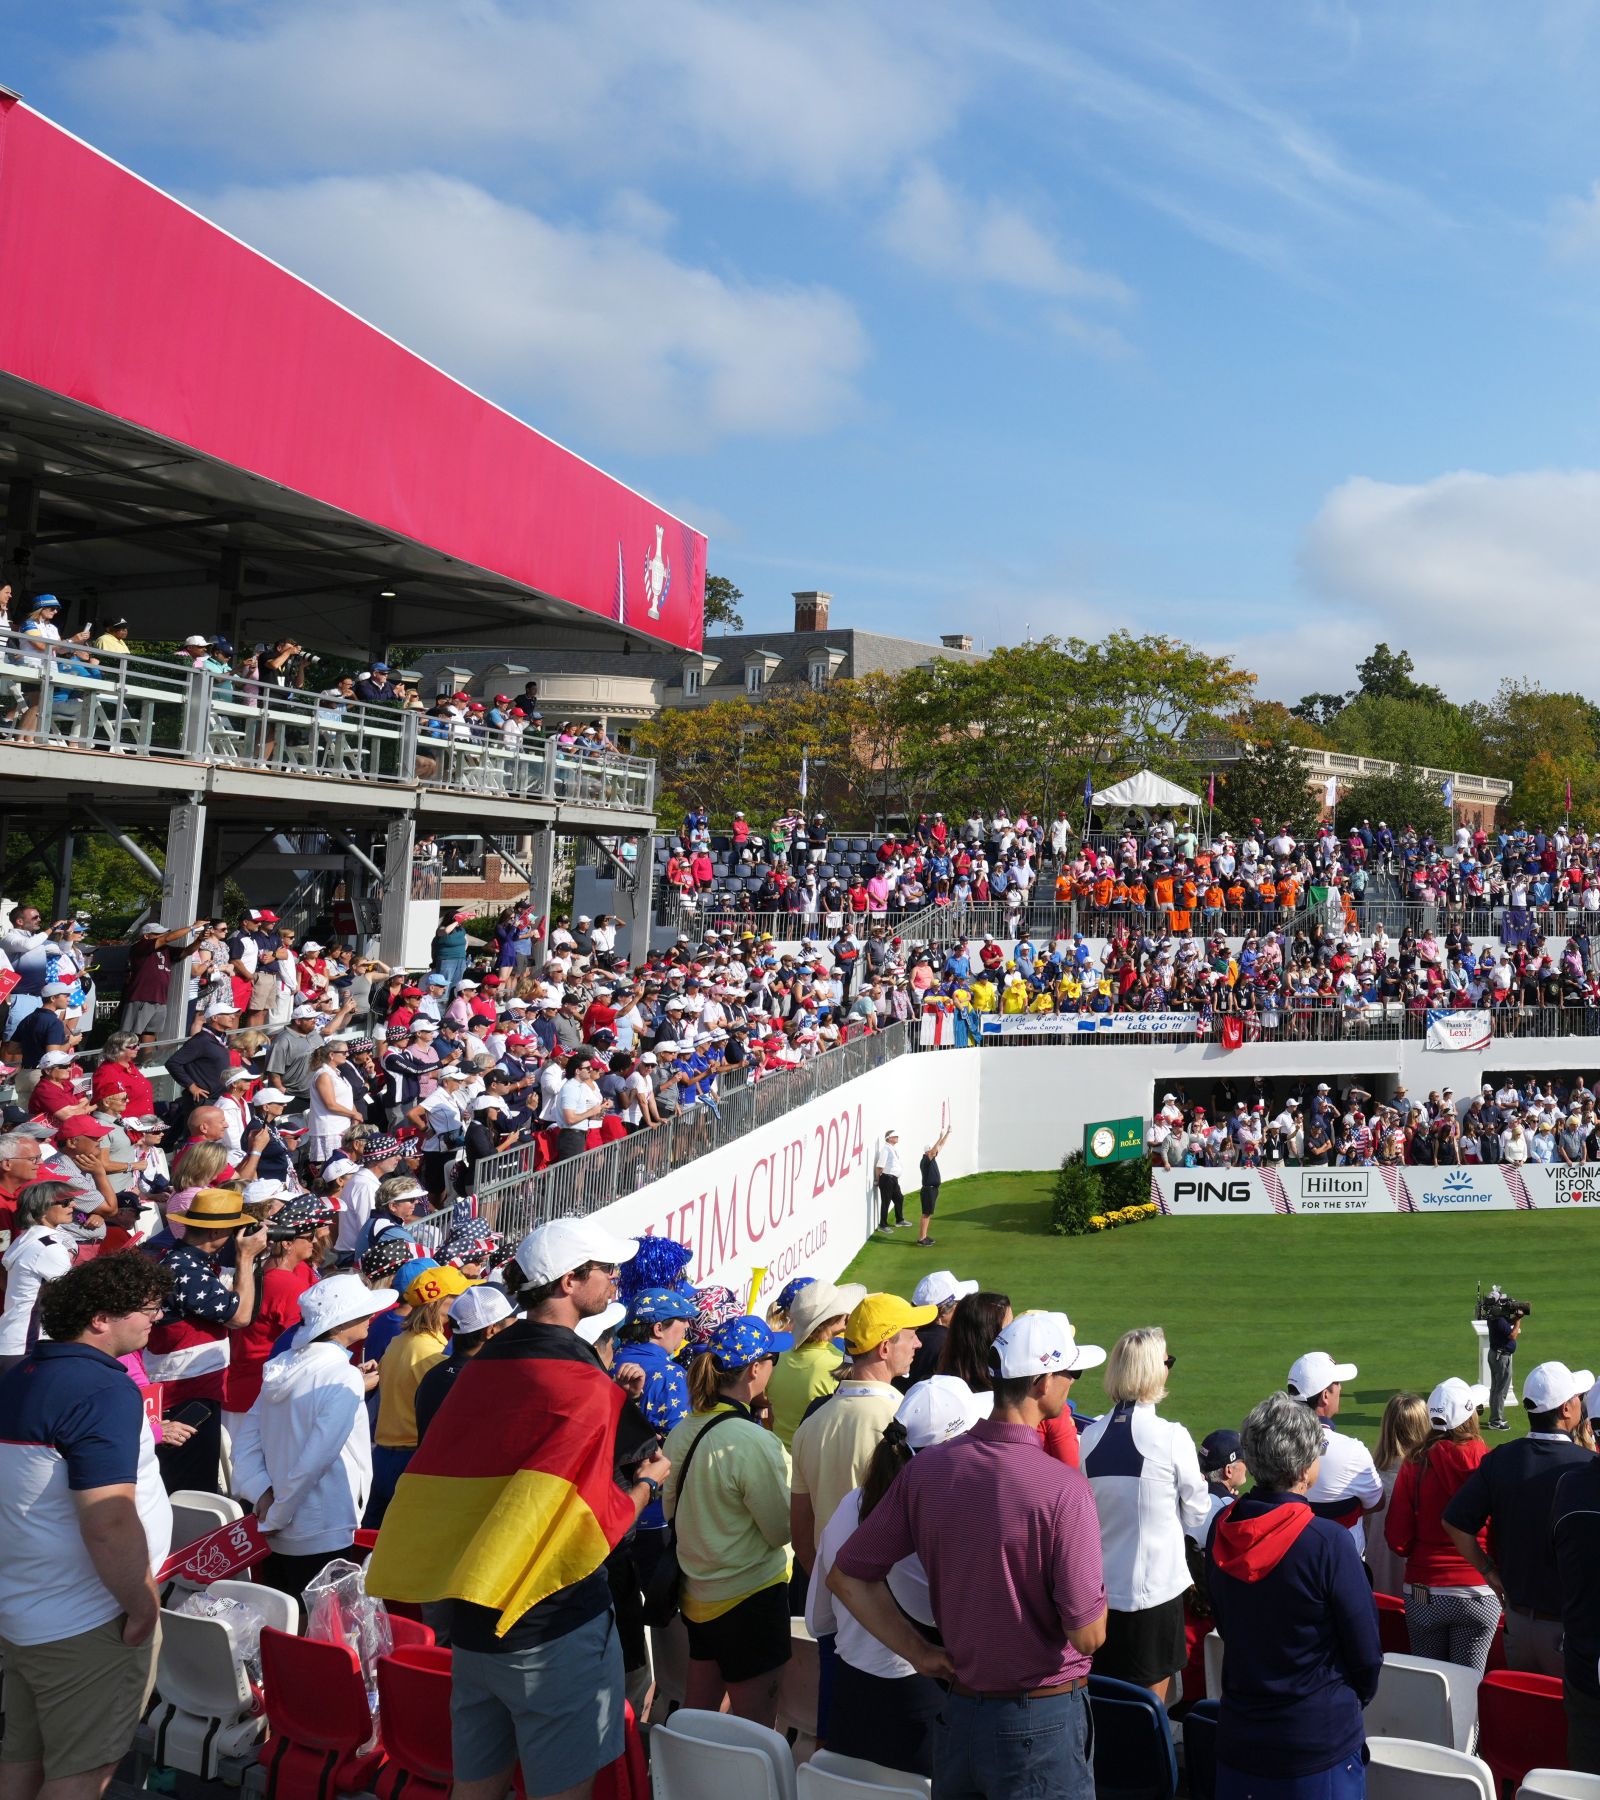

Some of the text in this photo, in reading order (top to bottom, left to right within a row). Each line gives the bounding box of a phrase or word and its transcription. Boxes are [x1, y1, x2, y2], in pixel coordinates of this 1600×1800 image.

[1159, 1014, 1196, 1023] Europe
[1120, 1138, 1141, 1147] ROLEX
[746, 1139, 803, 1242] CUP
[812, 1103, 864, 1199] 2024
[1174, 1181, 1251, 1203] PING
[1307, 1177, 1363, 1193] Hilton
[1556, 1179, 1595, 1191] IS FOR
[1302, 1201, 1367, 1209] FOR THE STAY
[1423, 1193, 1492, 1206] Skyscanner
[777, 1238, 803, 1282] GOLF
[804, 1219, 828, 1259] CLUB
[414, 1281, 441, 1303] 18
[228, 1522, 253, 1557] USA
